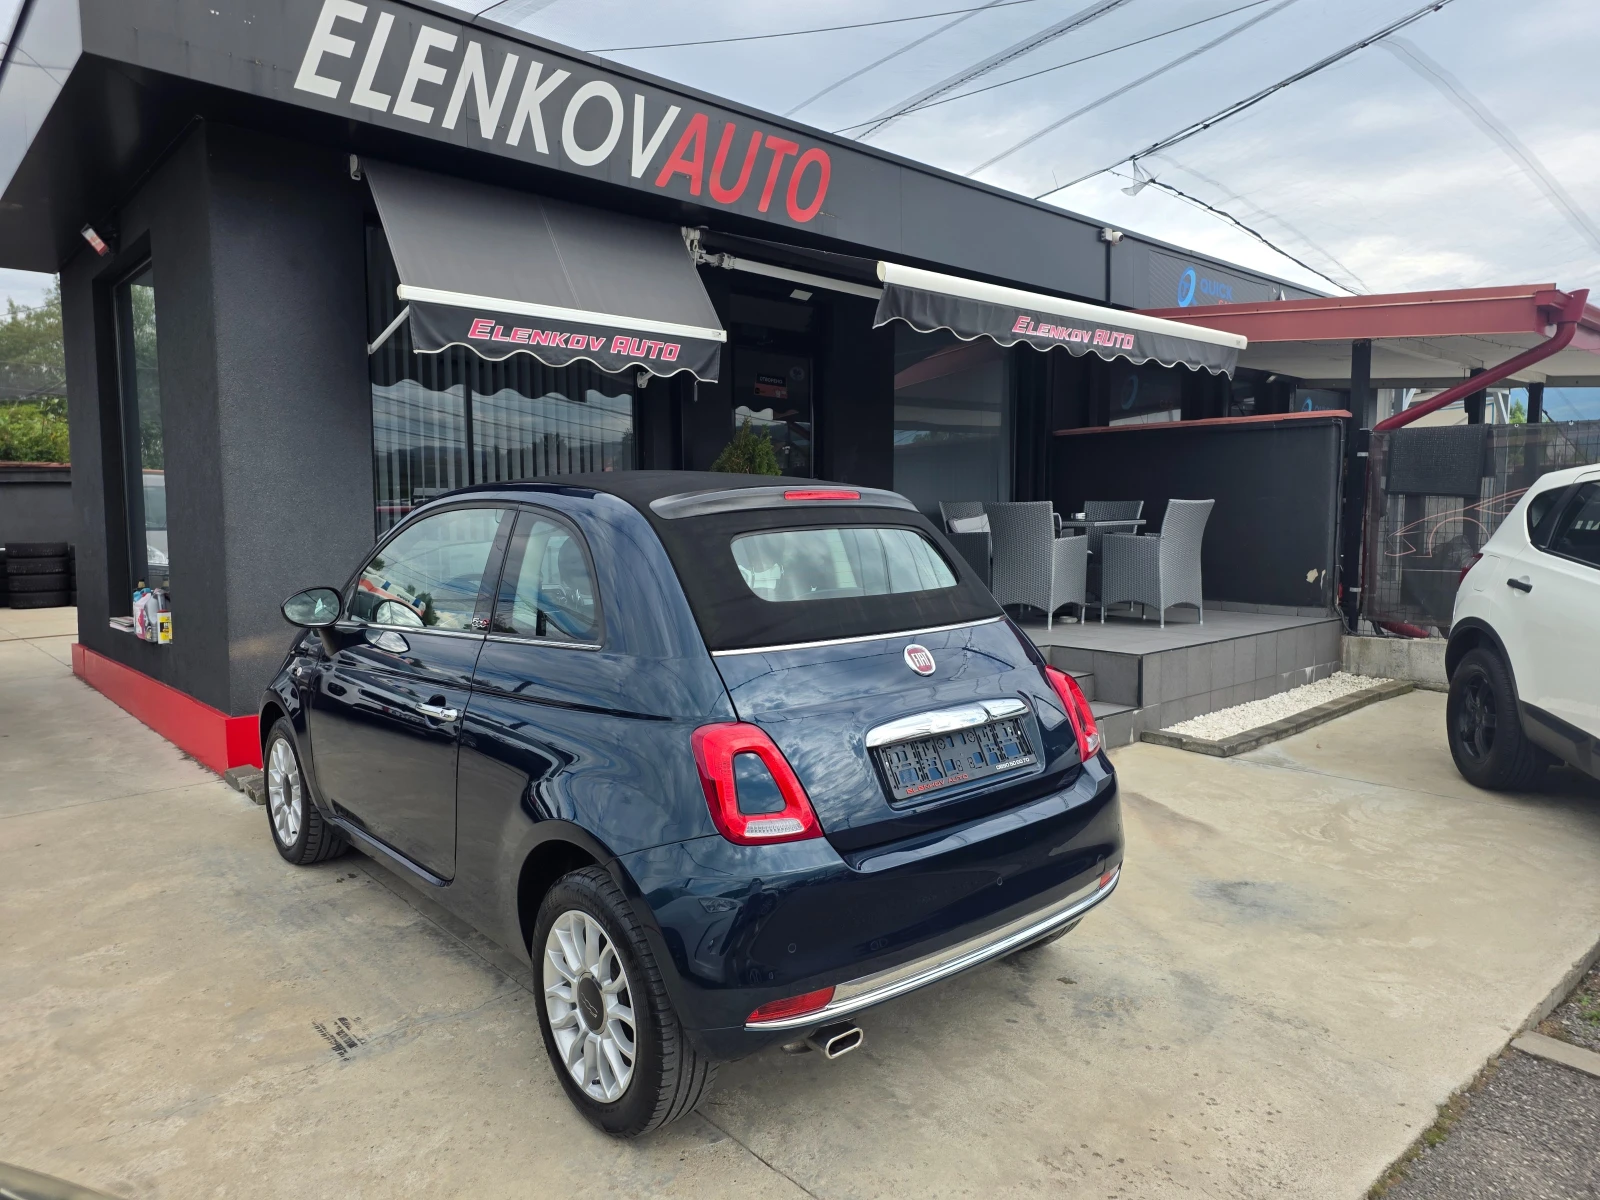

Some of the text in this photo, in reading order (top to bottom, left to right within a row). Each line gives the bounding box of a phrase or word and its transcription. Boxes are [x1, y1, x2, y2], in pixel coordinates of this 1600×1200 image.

[1200, 278, 1233, 300] QUICK
[610, 335, 681, 362] AUTO
[1093, 328, 1135, 350] AUTO
[911, 652, 931, 667] FIAT
